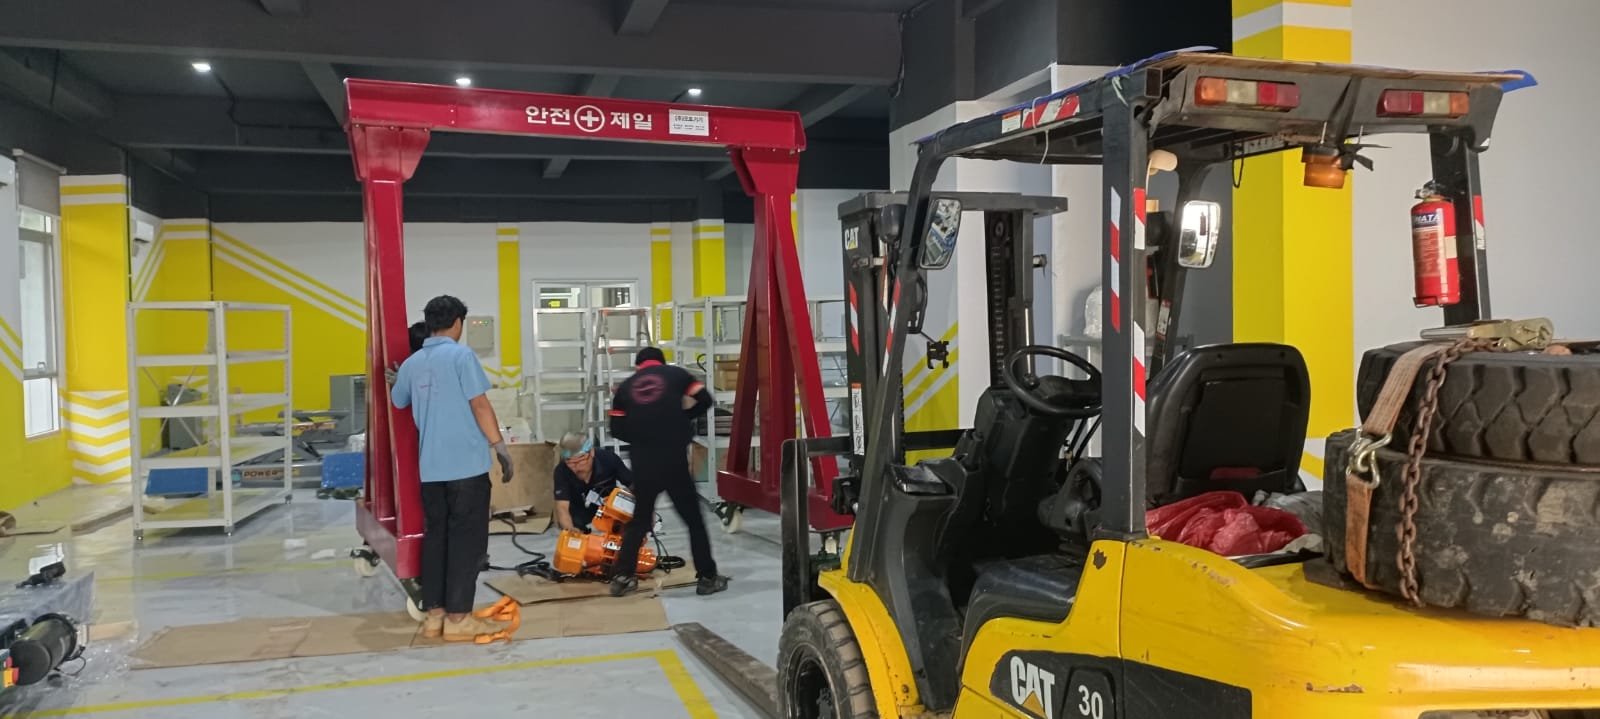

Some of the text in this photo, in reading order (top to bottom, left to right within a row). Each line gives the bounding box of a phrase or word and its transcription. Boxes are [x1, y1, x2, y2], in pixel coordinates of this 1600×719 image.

[525, 105, 653, 131] 안전 제일
[844, 226, 859, 250] CAT
[1010, 655, 1055, 719] CAT
[1078, 684, 1104, 719] 30
